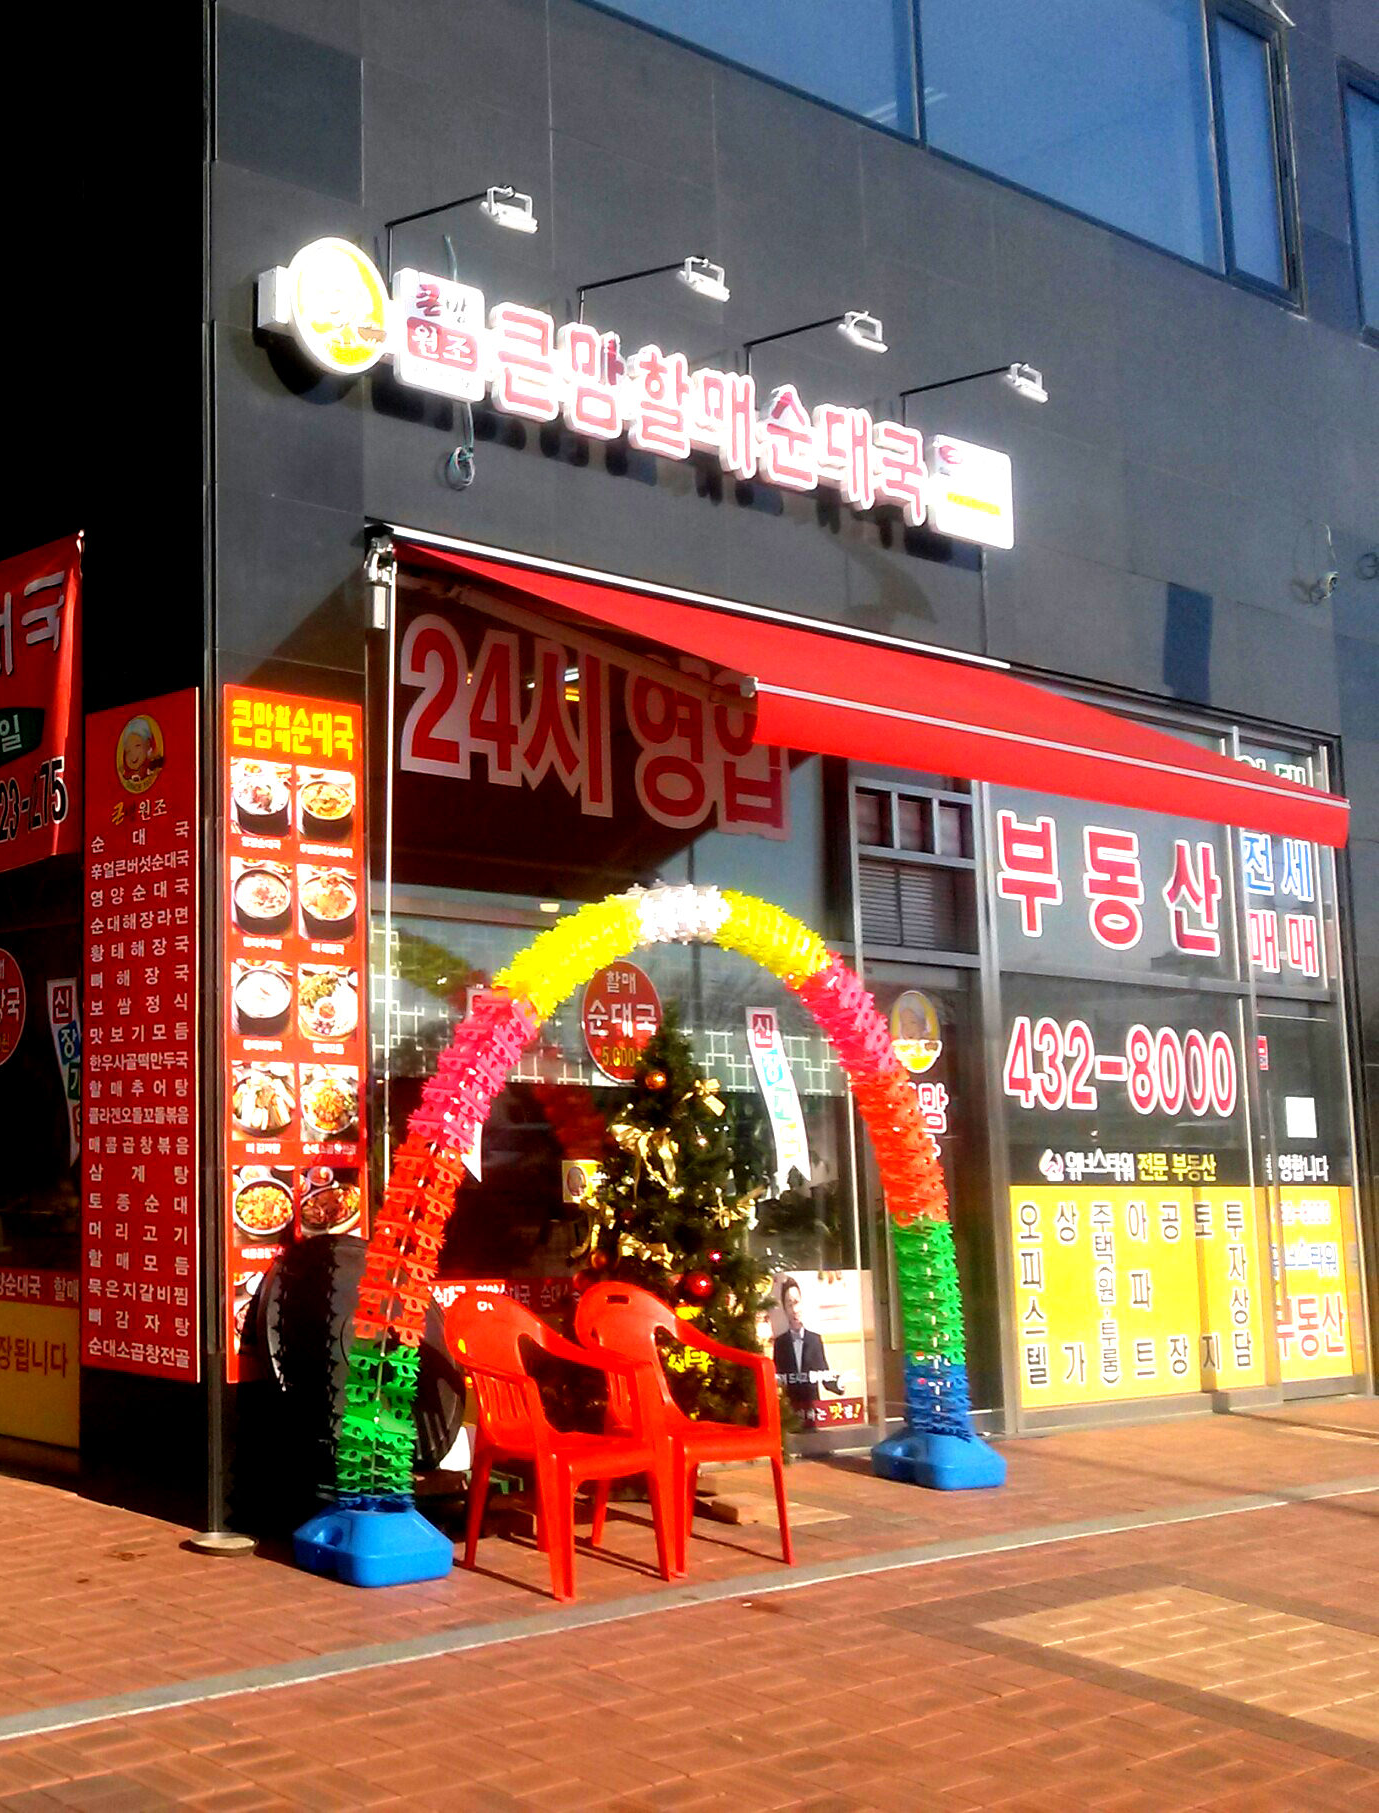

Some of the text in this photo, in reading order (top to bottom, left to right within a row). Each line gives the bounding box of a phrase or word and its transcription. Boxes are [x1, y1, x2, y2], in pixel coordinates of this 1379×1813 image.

[411, 324, 473, 365] 원조
[138, 799, 168, 822] 원조
[997, 810, 1221, 957] 부동산
[1242, 832, 1315, 903] 전세
[90, 906, 190, 935] 순대해장라면
[1248, 909, 1320, 978] 매매
[606, 970, 637, 994] 할매
[587, 999, 657, 1039] 순대국
[601, 1047, 644, 1068] 5.000
[1004, 1016, 1237, 1117] 432-8000
[1137, 1151, 1169, 1182] 전문
[1171, 1152, 1217, 1182] 부동산
[1020, 1203, 1049, 1386] 오피스텔
[88, 1337, 190, 1369] 순대소곱창전골
